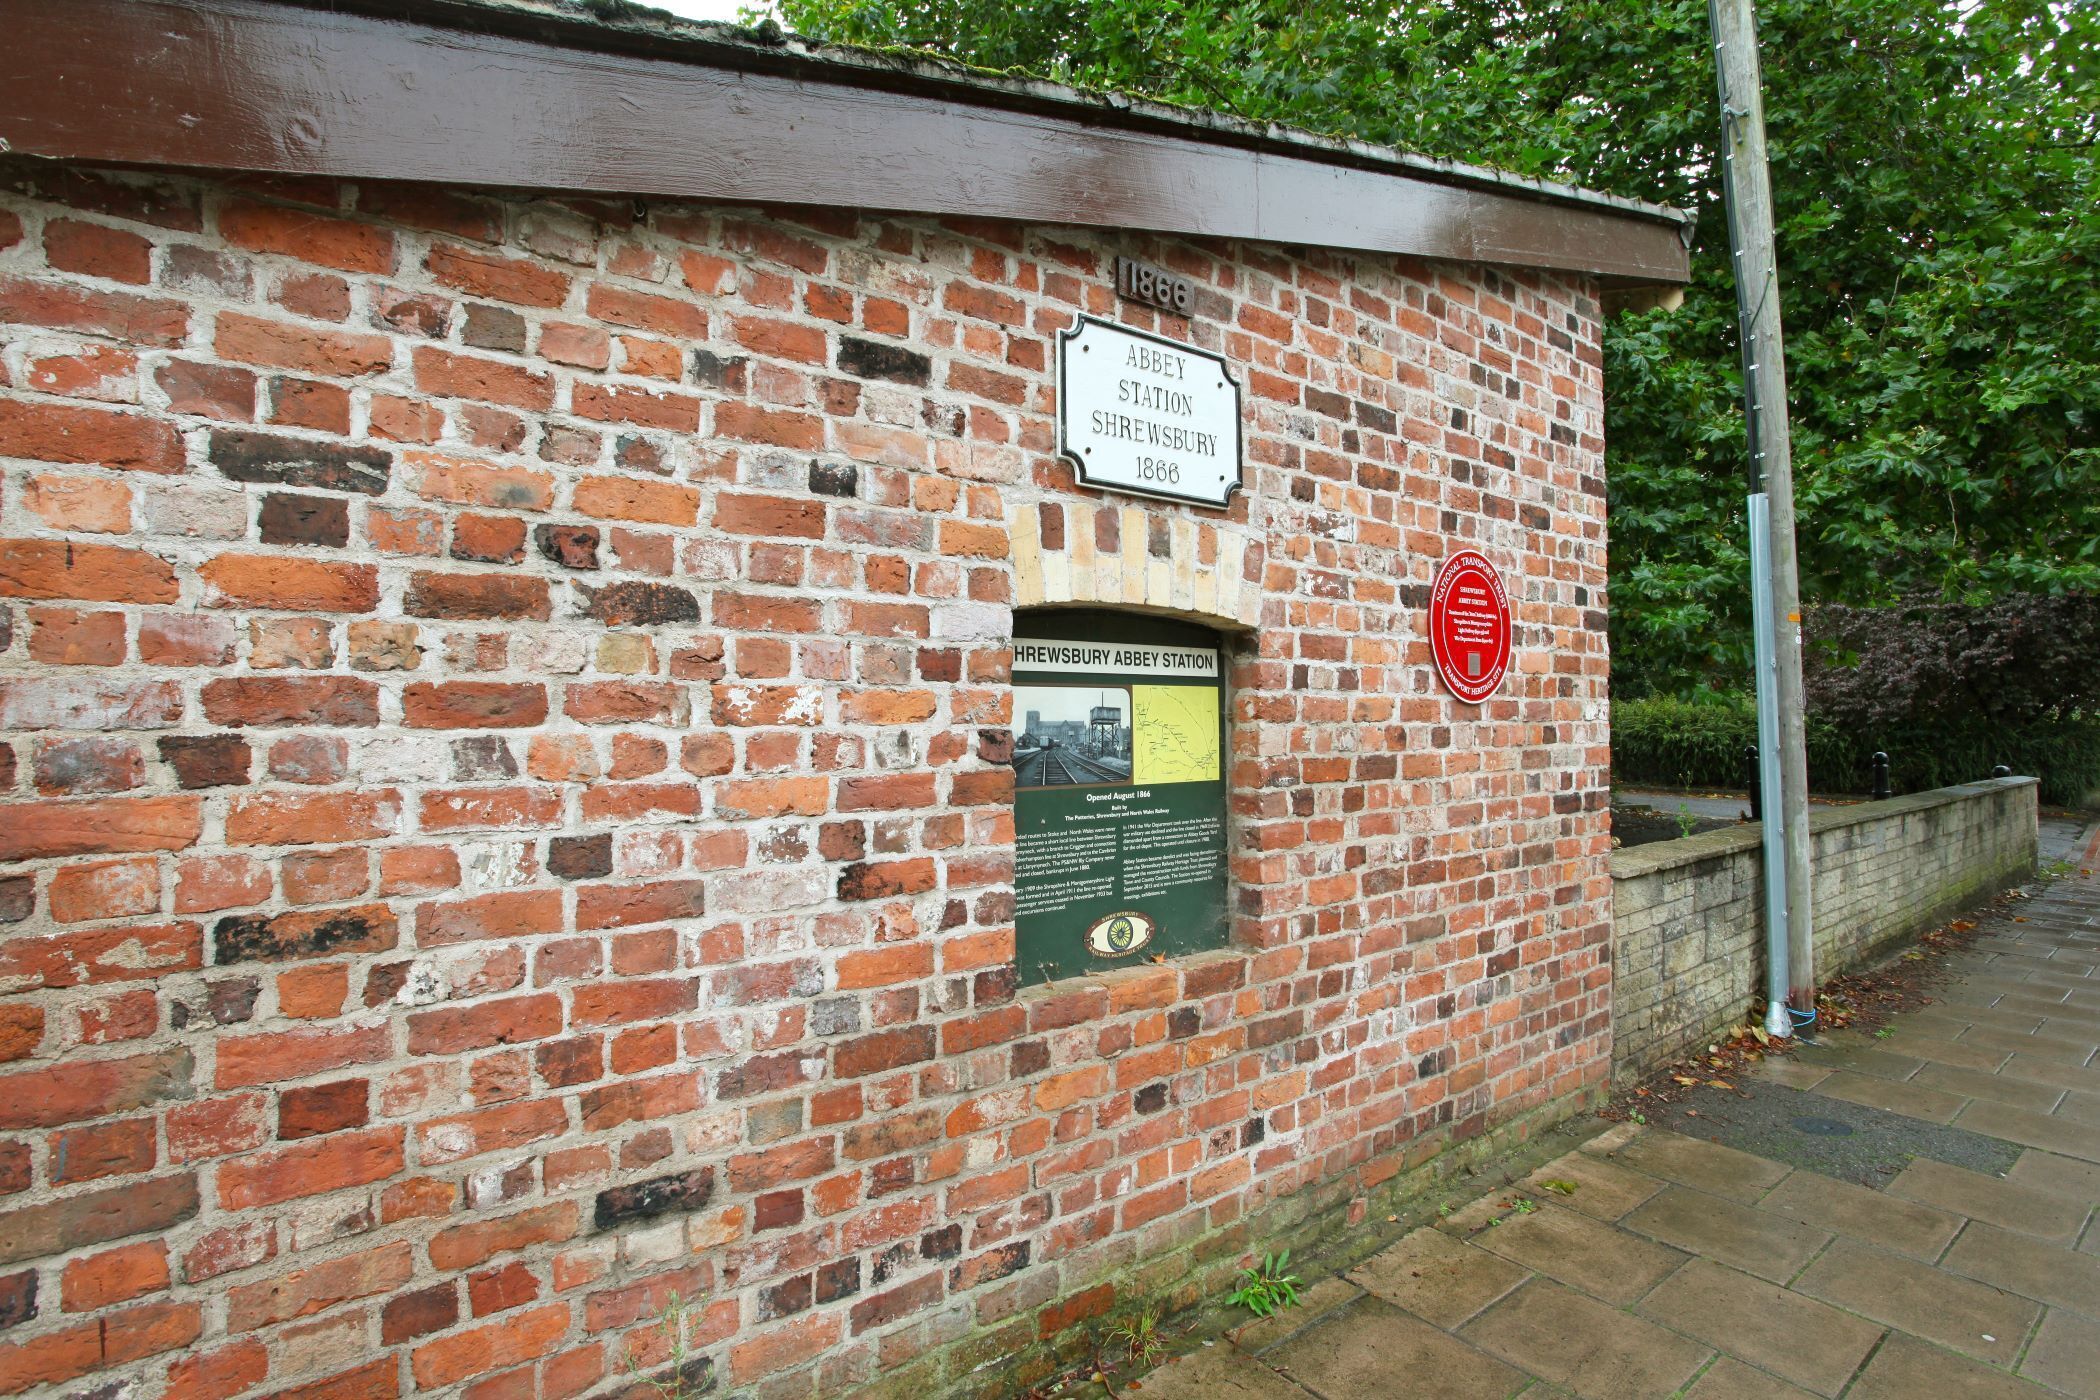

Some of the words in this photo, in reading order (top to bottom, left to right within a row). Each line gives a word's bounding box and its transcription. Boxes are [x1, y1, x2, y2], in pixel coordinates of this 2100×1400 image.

[1130, 261, 1187, 309] 1866
[1126, 344, 1186, 380] ABBEY
[1119, 379, 1193, 416] STATION
[1092, 410, 1217, 457] SHREWSBURY
[1136, 456, 1180, 484] 1866
[1436, 561, 1461, 603] NATIONAL
[1461, 556, 1494, 578] TRANSPORT
[1494, 578, 1507, 608] TRUST
[1014, 646, 1110, 665] HREWSBURY
[1114, 651, 1158, 667] ABBEY
[1162, 652, 1212, 669] STATION
[1445, 663, 1470, 694] TRANSPORT
[1471, 679, 1494, 694] HERITAGE
[1086, 793, 1112, 803] Opened
[1113, 792, 1135, 800] August
[1102, 911, 1138, 922] SHREWSBURY
[1088, 946, 1110, 957] RAILWAY
[1111, 948, 1136, 957] HERITAGE
